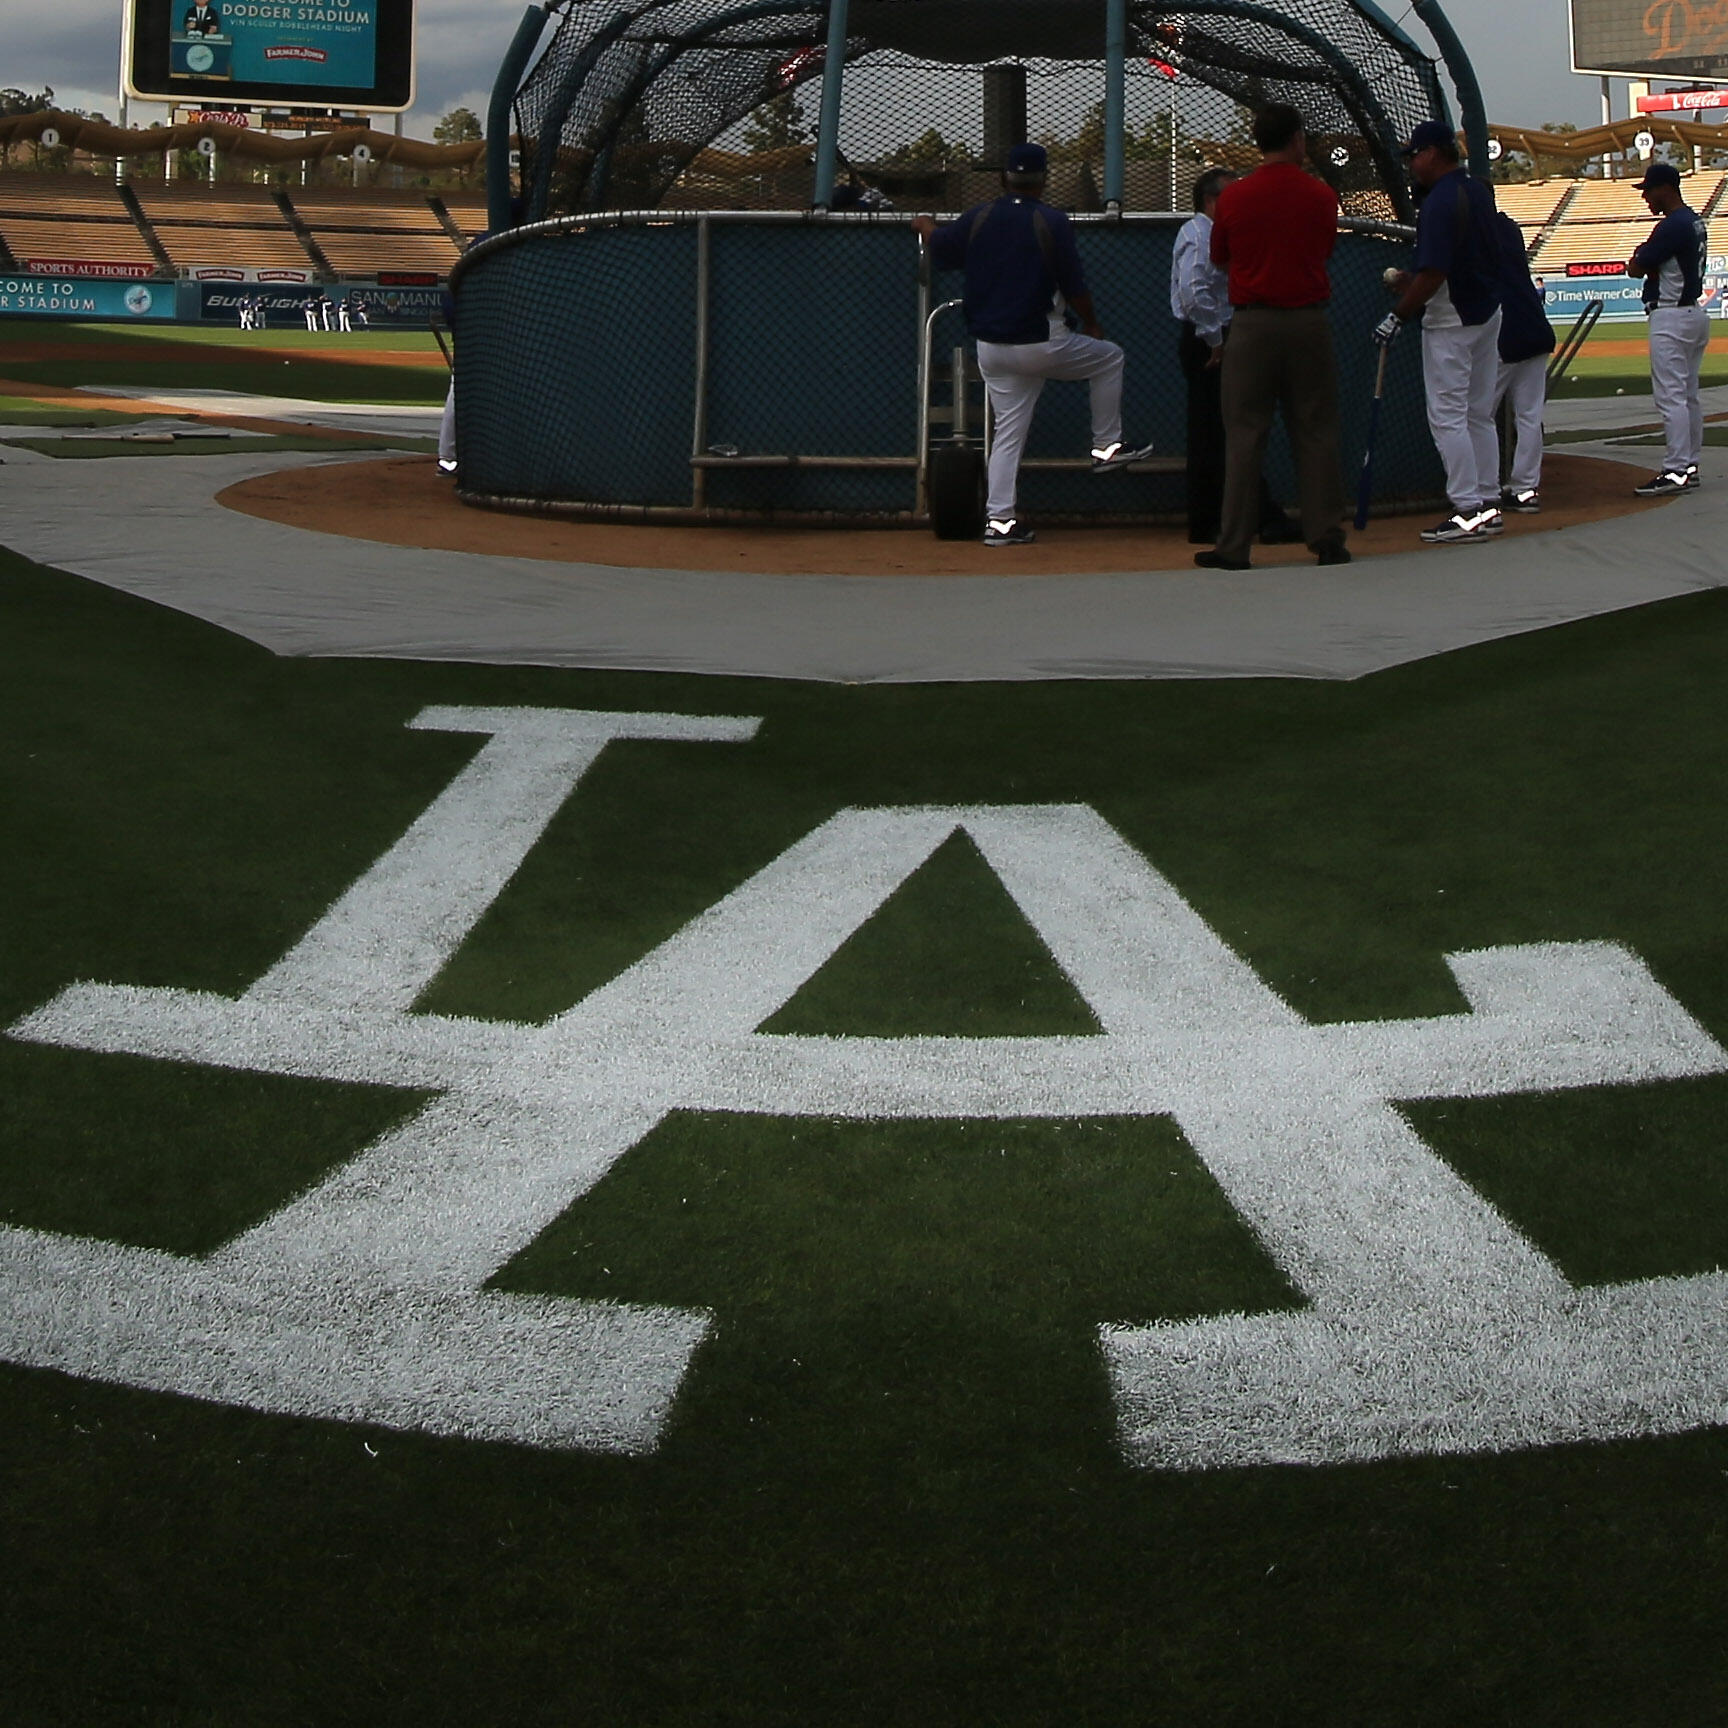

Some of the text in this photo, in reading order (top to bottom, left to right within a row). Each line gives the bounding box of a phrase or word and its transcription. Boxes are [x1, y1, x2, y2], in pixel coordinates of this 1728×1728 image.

[221, 3, 370, 25] DODGER STADIUM
[229, 19, 246, 27] VIN
[248, 20, 277, 29] SCULLY
[334, 24, 362, 33] NIGHT
[1639, 138, 1650, 147] 39
[29, 262, 150, 277] SPORTS AUTHORITY
[1568, 264, 1625, 276] SHARP
[53, 283, 74, 295] TO
[1555, 287, 1643, 301] Time Warner Cab
[17, 295, 96, 310] STADIUM
[265, 297, 305, 309] LIGH
[350, 290, 388, 306] SAN
